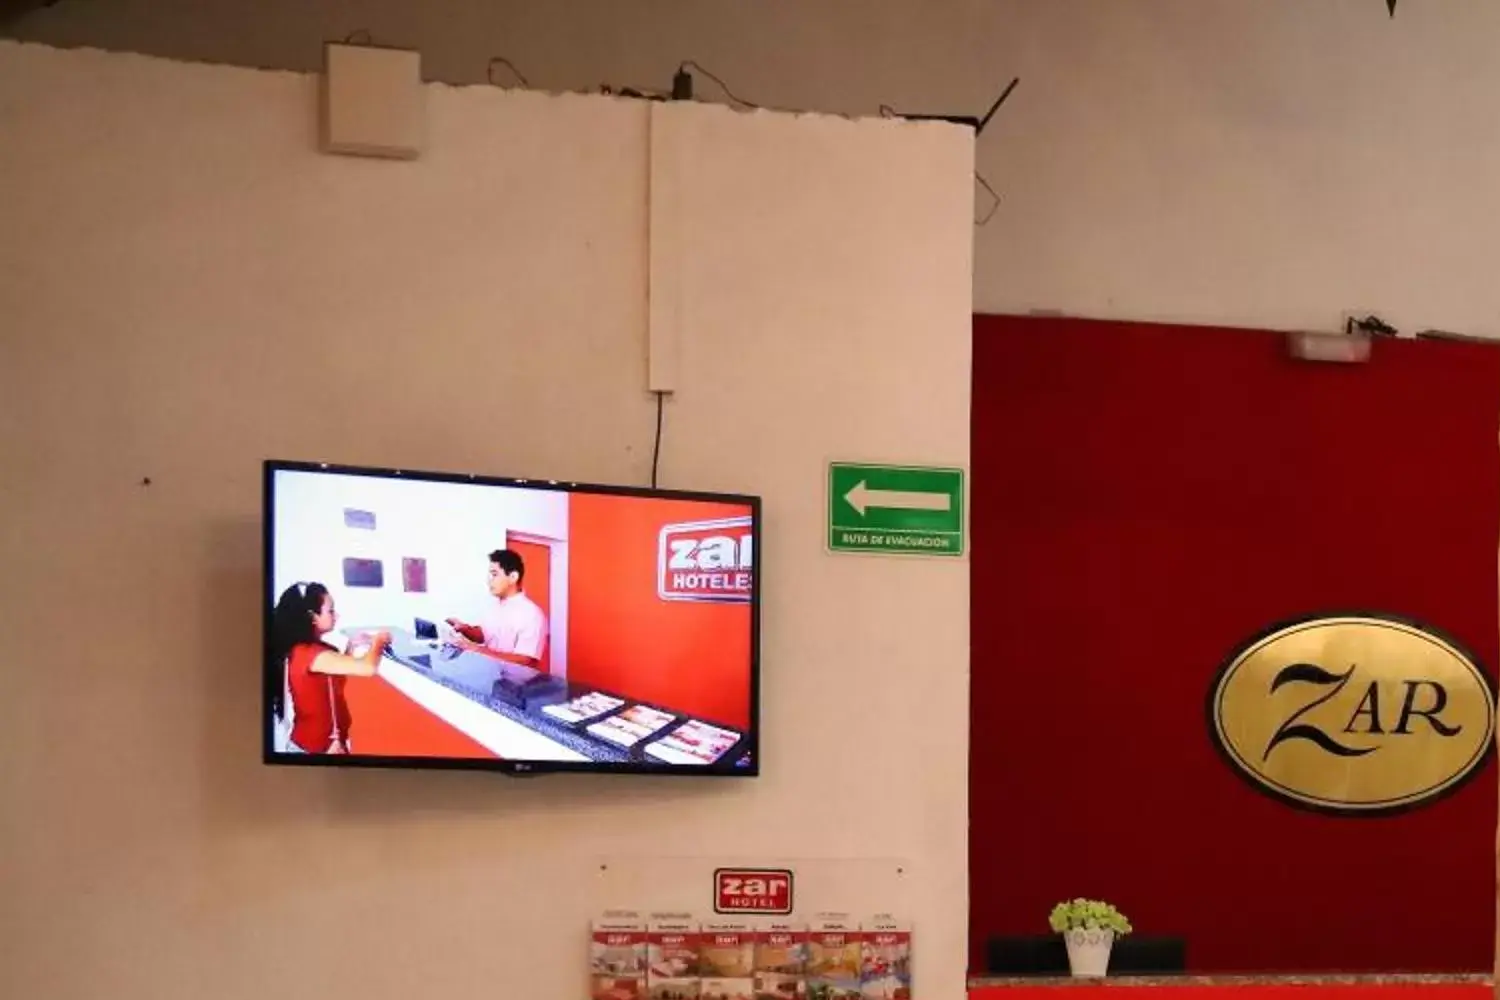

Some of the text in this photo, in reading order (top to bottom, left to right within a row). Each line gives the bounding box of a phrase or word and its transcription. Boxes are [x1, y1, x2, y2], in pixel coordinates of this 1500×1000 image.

[843, 533, 868, 545] RUTA
[870, 535, 884, 545] DE
[722, 878, 787, 897] zar
[731, 897, 777, 908] HOTEL
